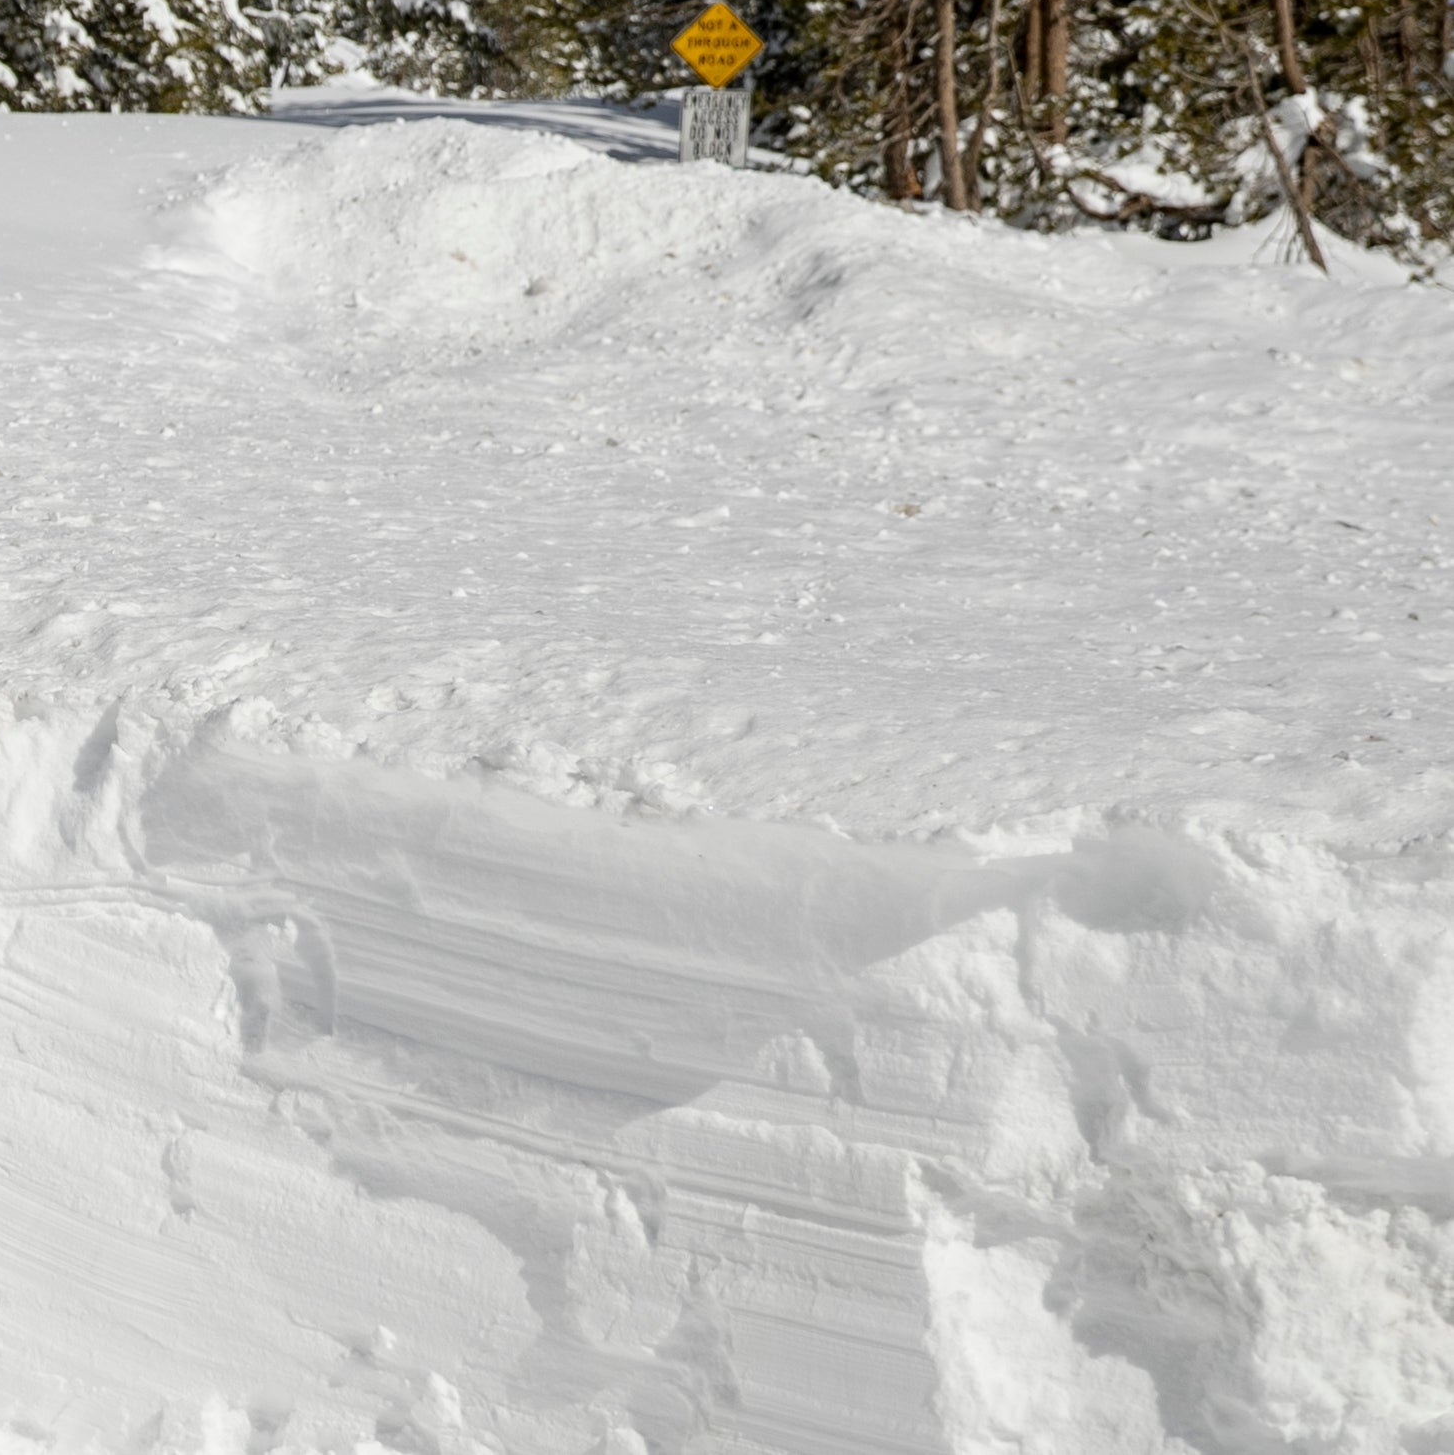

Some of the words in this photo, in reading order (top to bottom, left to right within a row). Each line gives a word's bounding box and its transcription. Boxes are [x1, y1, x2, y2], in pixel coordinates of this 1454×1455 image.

[697, 19, 723, 31] NOT
[729, 19, 738, 31] A
[687, 36, 751, 48] THROUGH
[698, 54, 735, 66] ROAD
[683, 92, 746, 108] EMERGENCY
[691, 108, 739, 124] ACCESS
[689, 124, 706, 139] DO
[714, 124, 739, 140] NOT
[693, 141, 731, 157] BLOCK
